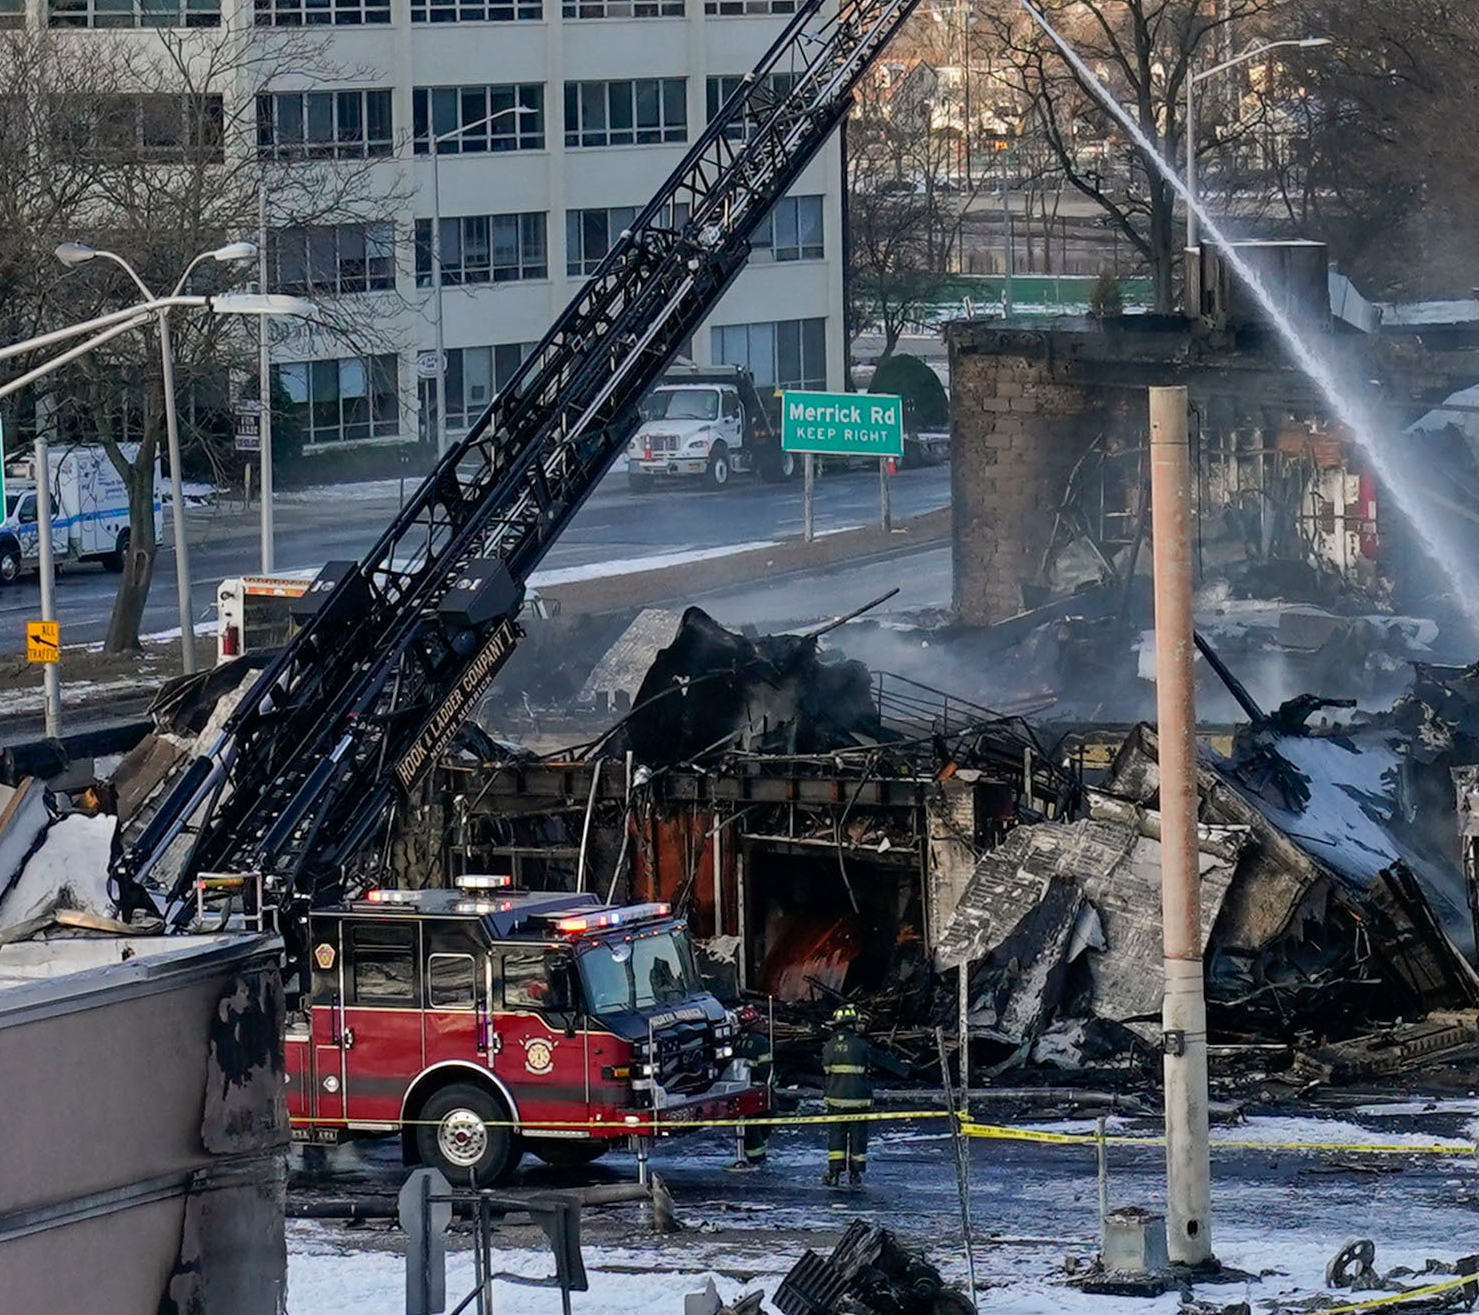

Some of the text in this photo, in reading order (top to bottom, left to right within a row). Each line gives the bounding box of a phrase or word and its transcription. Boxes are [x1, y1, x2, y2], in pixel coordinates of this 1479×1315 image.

[789, 402, 896, 426] Merrick Rd
[796, 426, 889, 442] KEEP RIGHT
[399, 741, 429, 786] HOOK
[430, 688, 465, 737] LADDER
[462, 635, 507, 693] COMPANY
[429, 675, 493, 761] NORTH MERRICK
